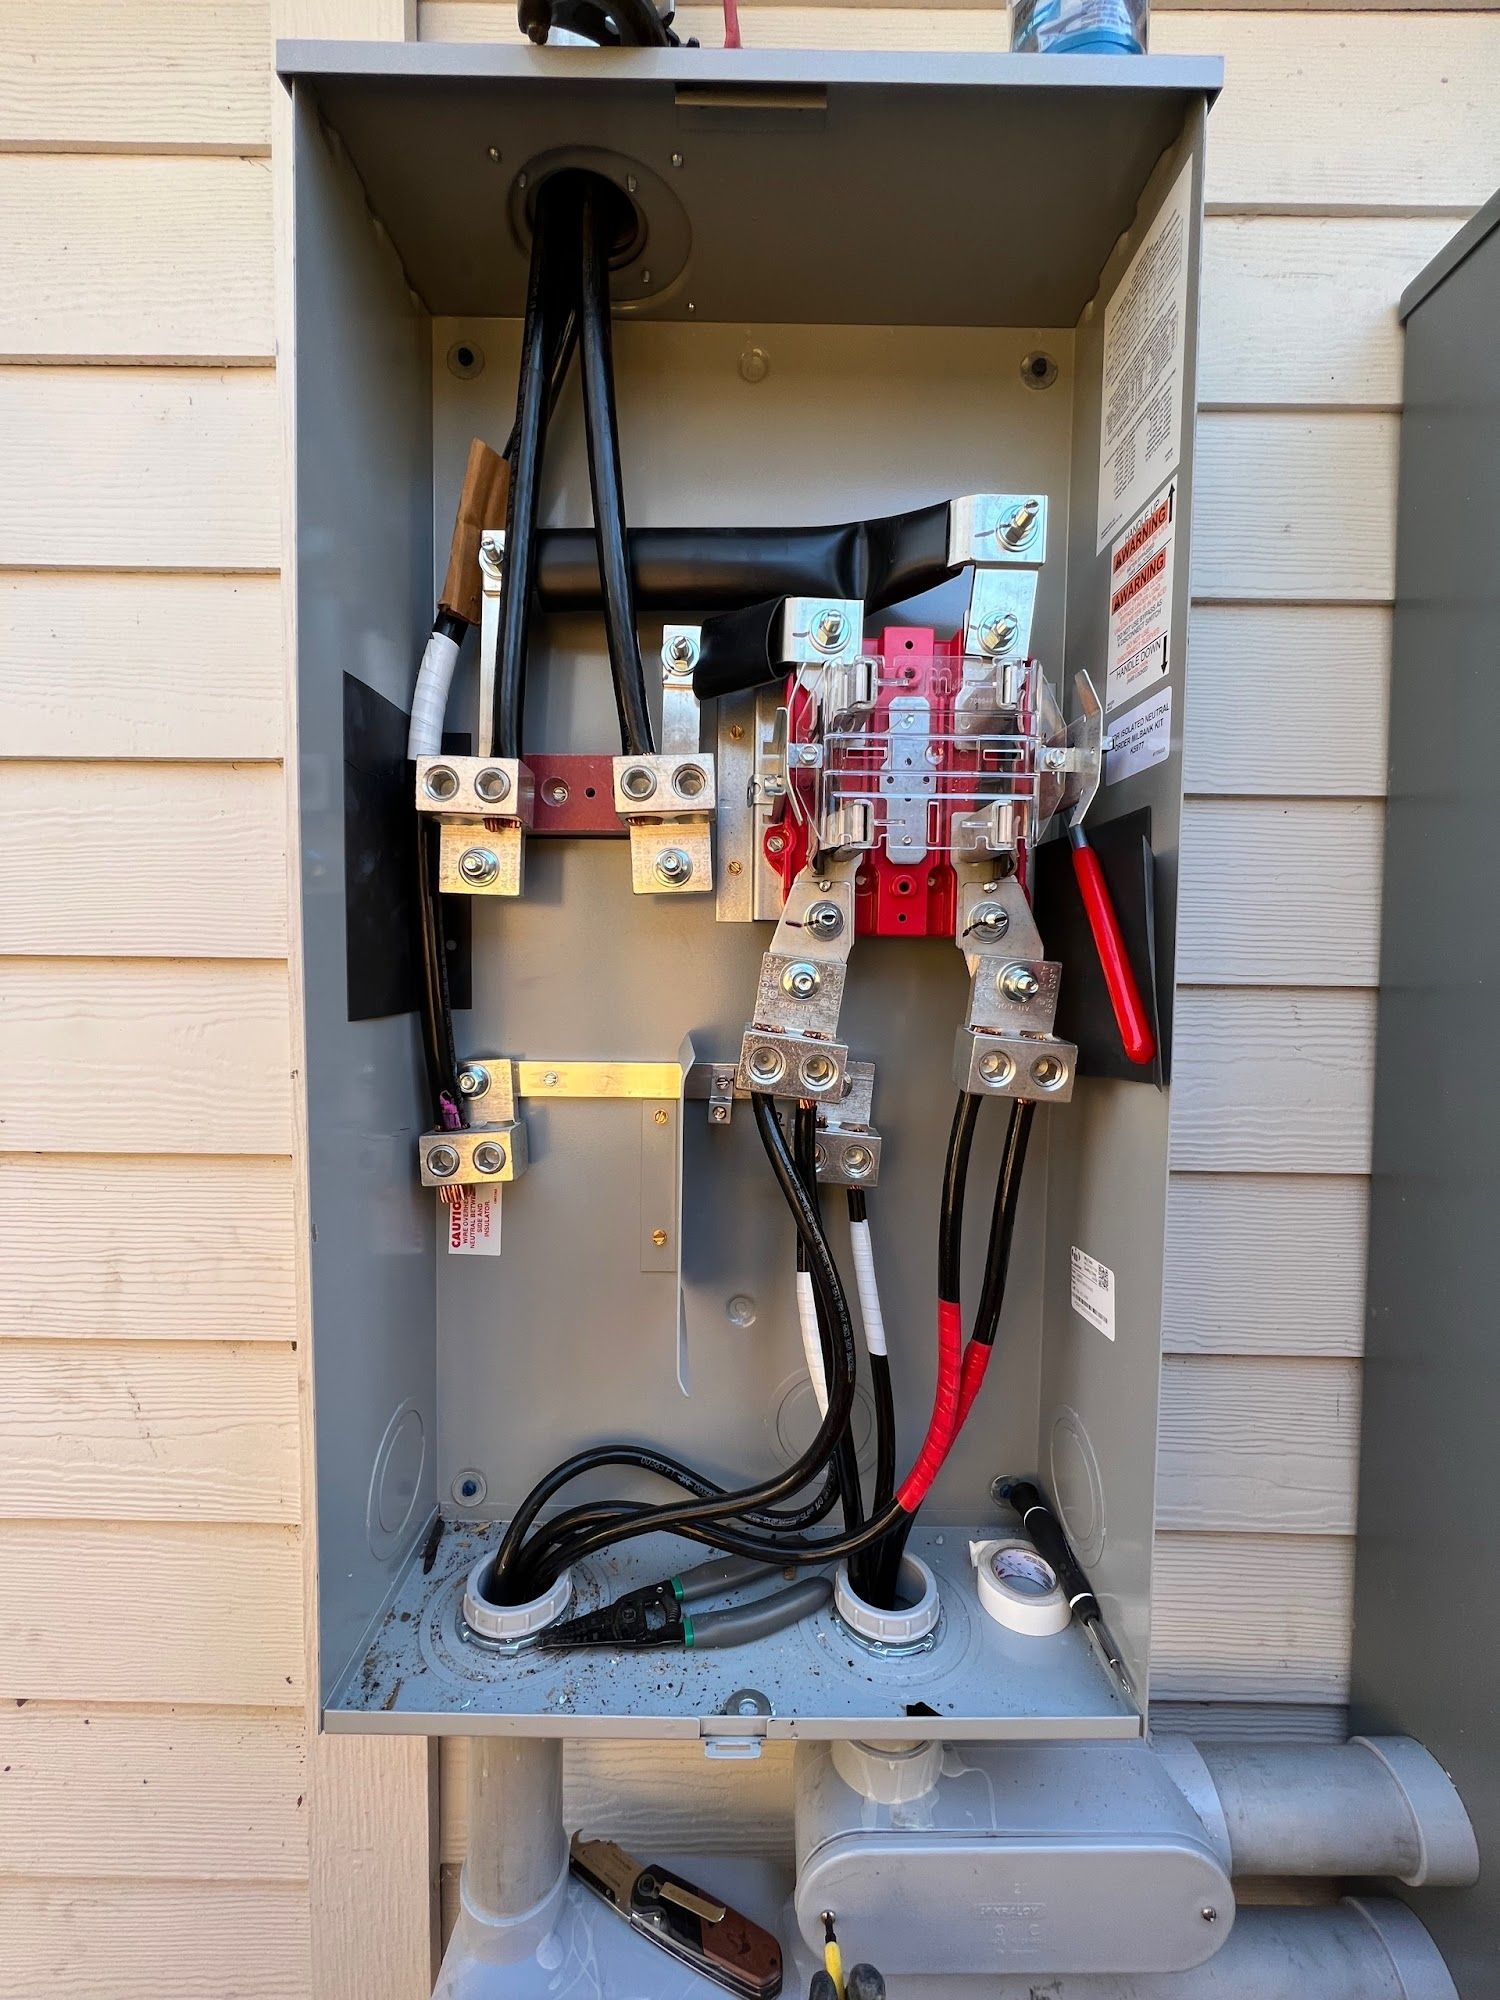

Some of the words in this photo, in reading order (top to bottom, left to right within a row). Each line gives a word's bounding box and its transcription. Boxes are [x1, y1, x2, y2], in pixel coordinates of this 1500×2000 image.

[1121, 503, 1166, 564] WARNING
[1119, 551, 1164, 606] WARNING
[1117, 631, 1122, 642] DO
[1122, 624, 1131, 637] NOT
[1131, 617, 1139, 630] USE
[1140, 602, 1157, 623] BYPASS
[1157, 597, 1162, 608] AS
[1120, 620, 1144, 646] DISCONNECT
[1145, 606, 1161, 626] SWITCH
[1116, 654, 1139, 680] HANDLE
[1140, 638, 1160, 662] DOWN
[1114, 735, 1130, 752] ORDER
[1131, 722, 1153, 742] MILBANK
[1154, 717, 1163, 730] KIT
[1120, 716, 1144, 738] ISOLATED
[1144, 700, 1169, 723] NEUTRAL
[452, 1201, 461, 1248] CAUTIO
